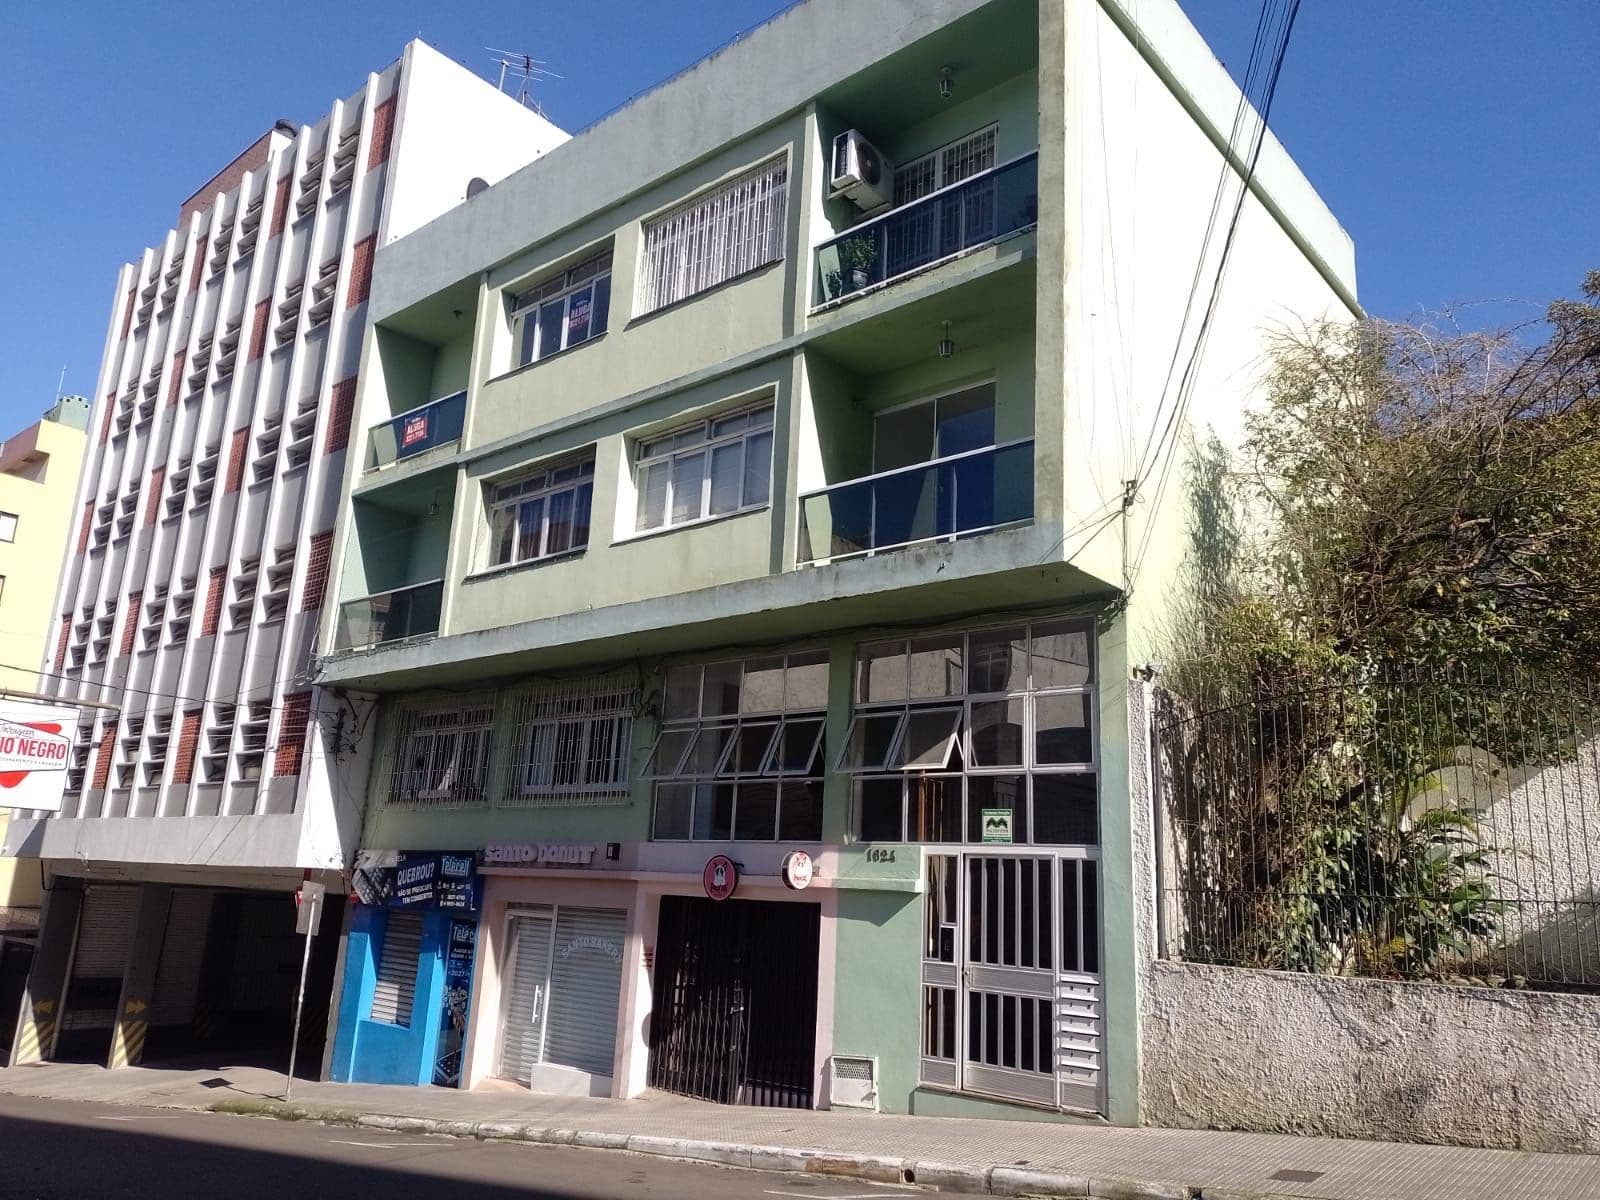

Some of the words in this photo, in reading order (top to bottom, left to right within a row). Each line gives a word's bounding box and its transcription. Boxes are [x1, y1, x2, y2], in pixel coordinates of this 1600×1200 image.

[407, 420, 425, 435] ALUGA
[17, 738, 67, 760] NEGRO
[397, 861, 435, 886] QUEBROU?
